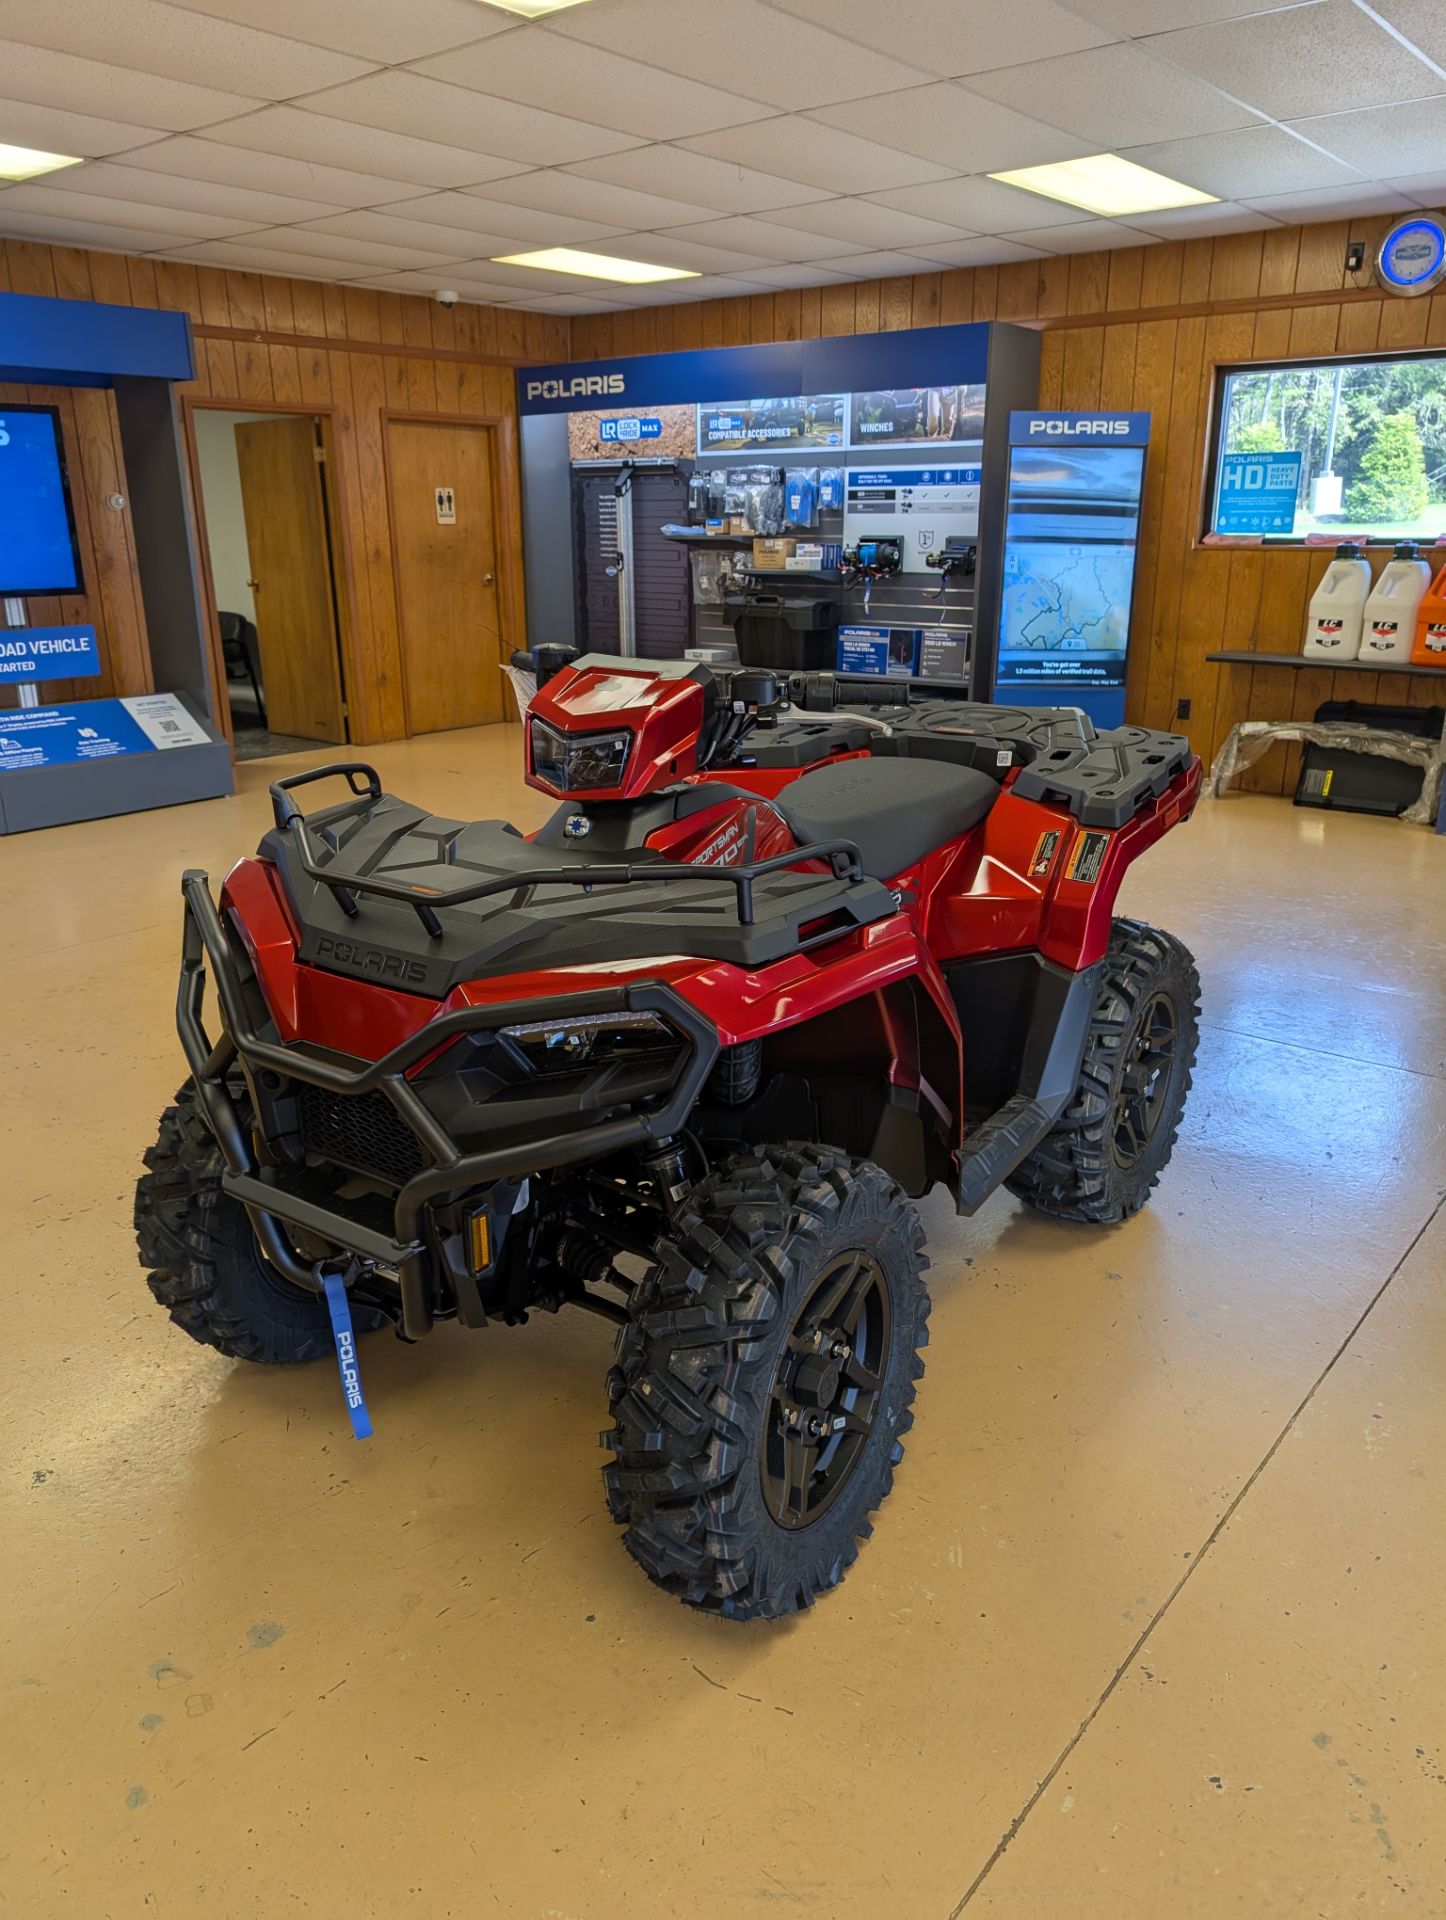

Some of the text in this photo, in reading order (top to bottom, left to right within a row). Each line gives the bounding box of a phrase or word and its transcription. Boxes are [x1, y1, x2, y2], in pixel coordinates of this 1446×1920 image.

[527, 374, 625, 400] POLARIS
[619, 421, 638, 430] LOCK
[641, 424, 659, 433] MAX
[860, 422, 893, 433] WINCHES
[1030, 420, 1129, 435] POLARIS
[708, 427, 791, 441] COMPATIBLE ACCESSORIES
[1225, 455, 1274, 463] POLARIS
[1222, 464, 1264, 490] HD
[29, 637, 90, 655] VEHICLE
[316, 937, 428, 983] POLARIS
[338, 1331, 362, 1409] POLARIS
